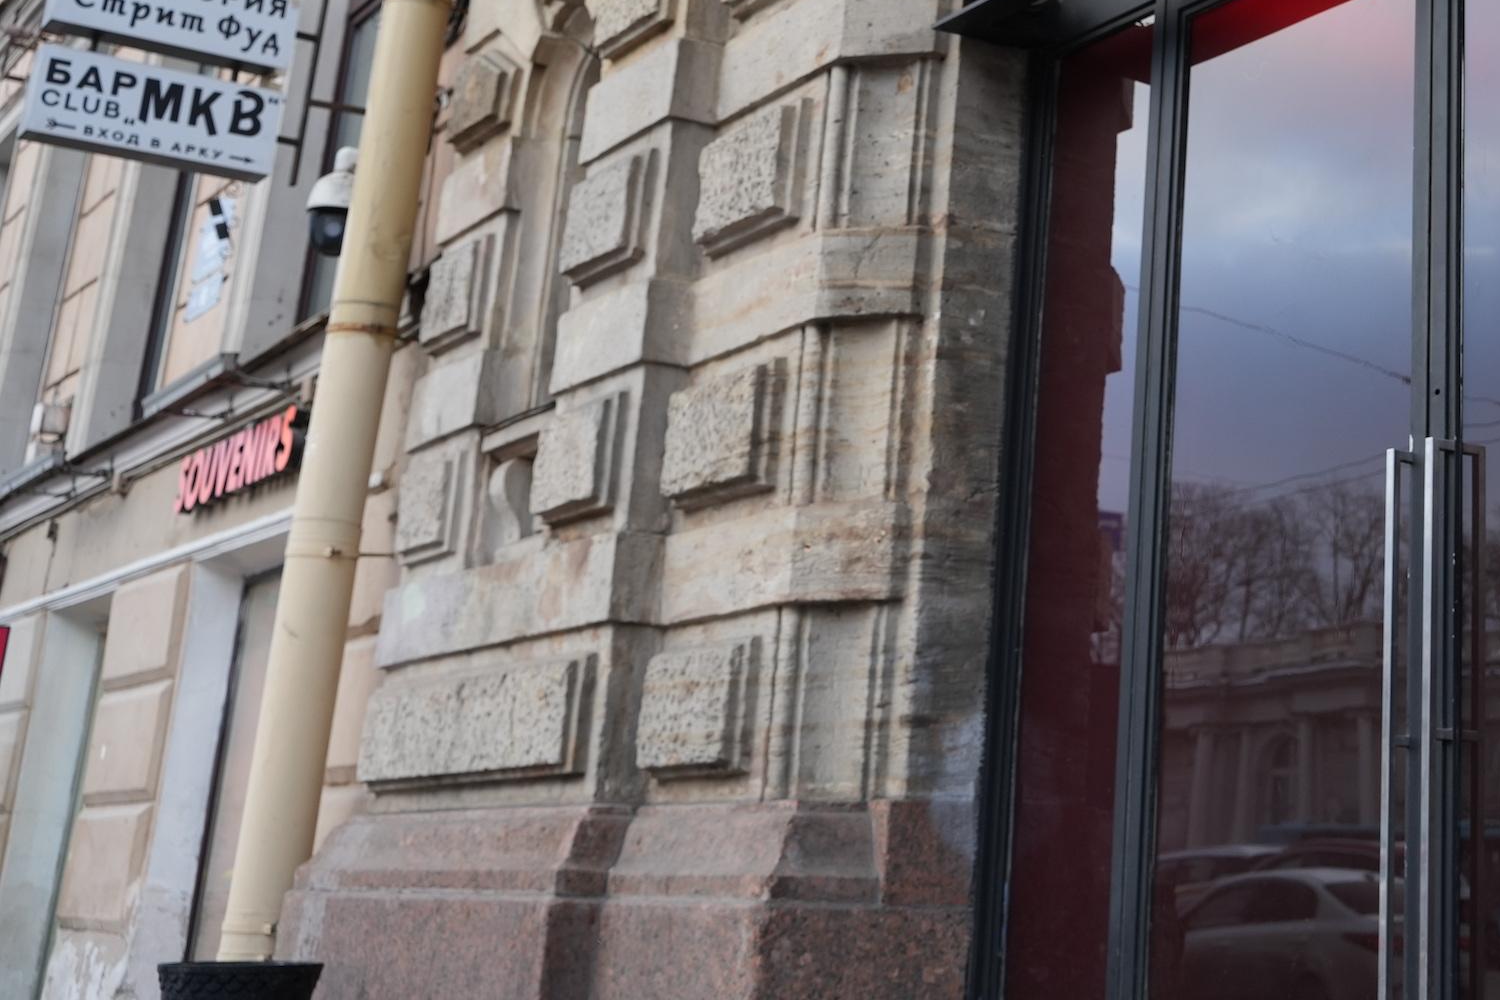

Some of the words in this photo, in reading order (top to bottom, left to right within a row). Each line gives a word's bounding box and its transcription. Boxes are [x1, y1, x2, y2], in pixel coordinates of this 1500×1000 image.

[45, 57, 138, 97] БАР
[41, 89, 121, 120] CLUB
[83, 125, 140, 147] ВХОД
[170, 141, 224, 160] АРКУ
[173, 404, 297, 515] SOUVENIRS
